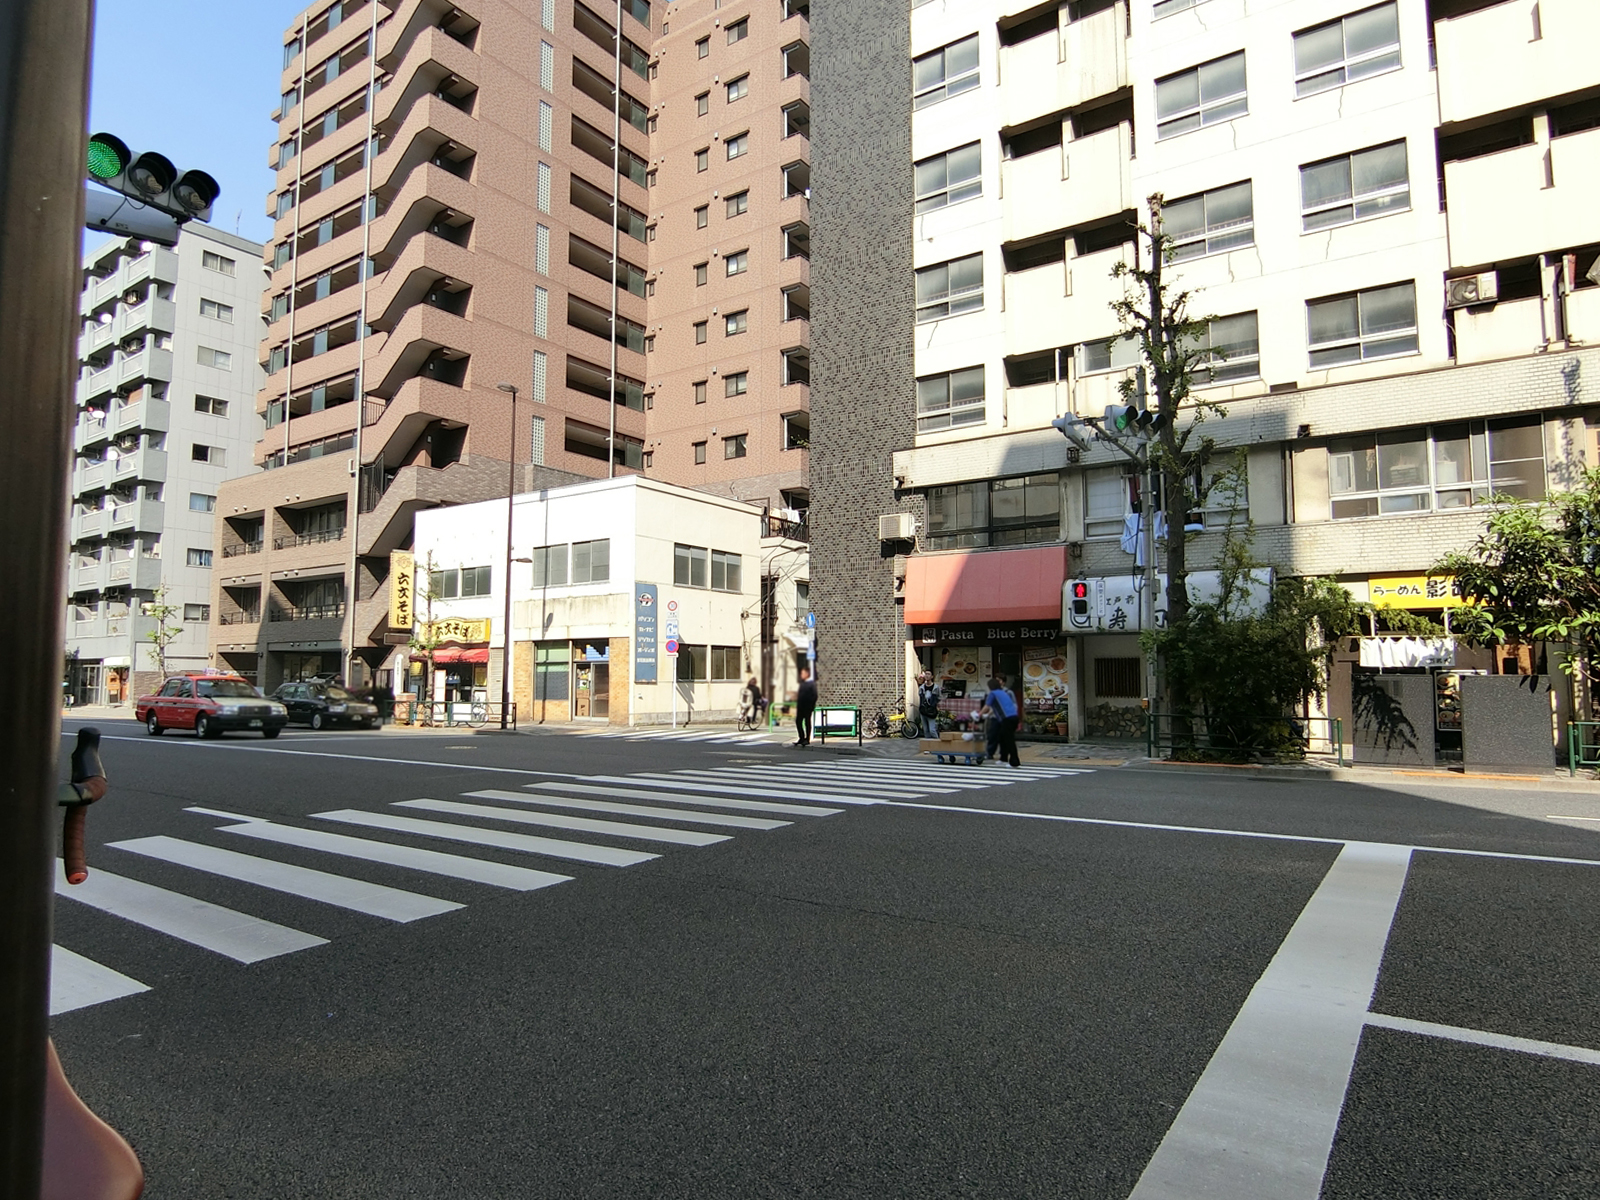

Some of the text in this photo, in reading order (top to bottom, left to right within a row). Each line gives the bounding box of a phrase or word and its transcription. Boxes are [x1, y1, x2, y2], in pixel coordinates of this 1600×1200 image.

[1373, 585, 1421, 596] らーめん
[396, 572, 410, 626] 六文そば
[941, 627, 1058, 640] Pasta Blue Berry
